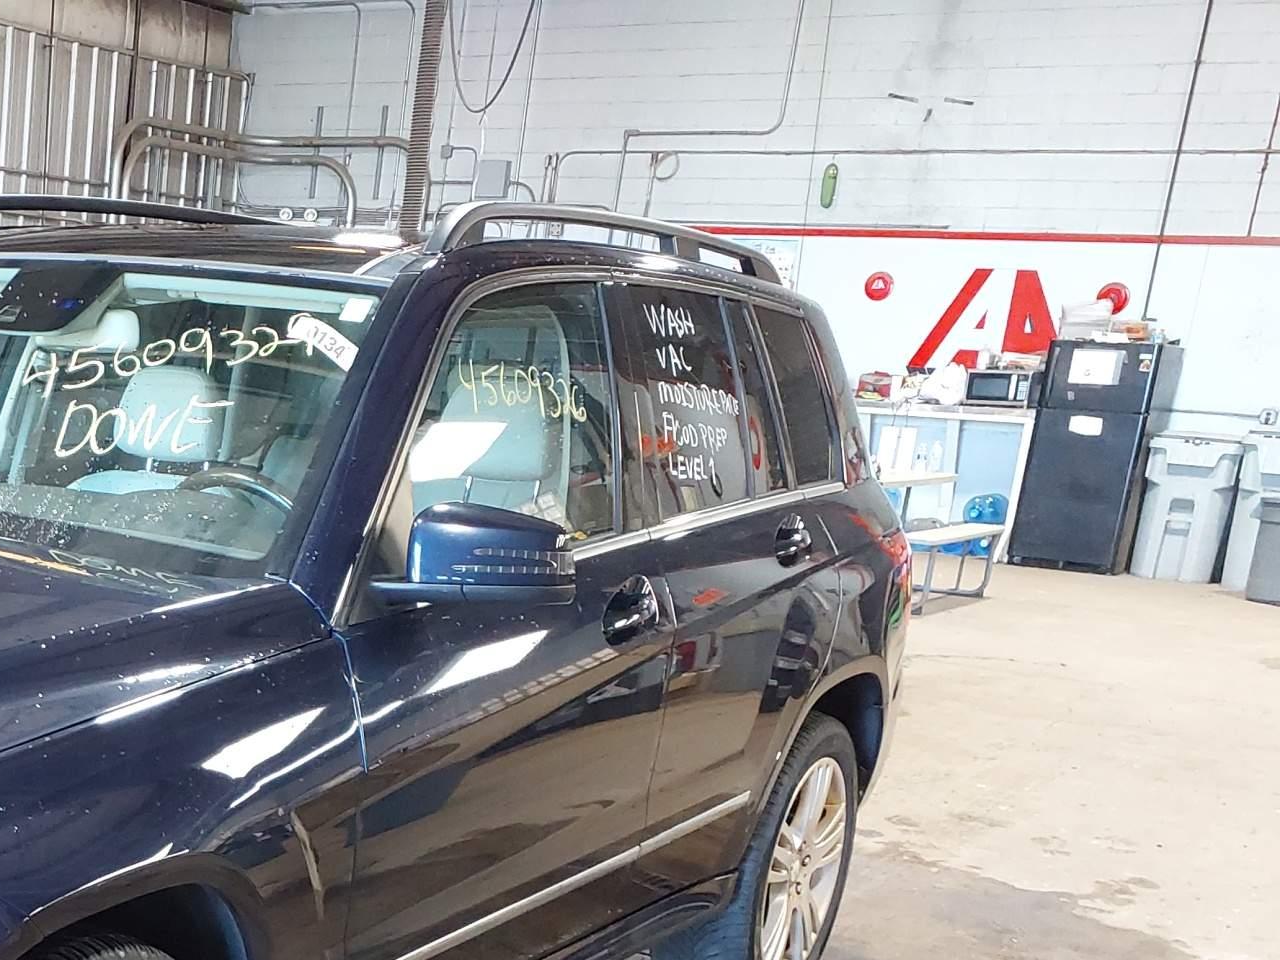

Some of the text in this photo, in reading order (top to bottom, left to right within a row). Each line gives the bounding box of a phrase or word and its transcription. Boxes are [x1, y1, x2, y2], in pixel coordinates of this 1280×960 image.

[643, 303, 696, 339] WASH
[656, 343, 693, 377] VAC
[669, 450, 716, 486] LEVEL 1
